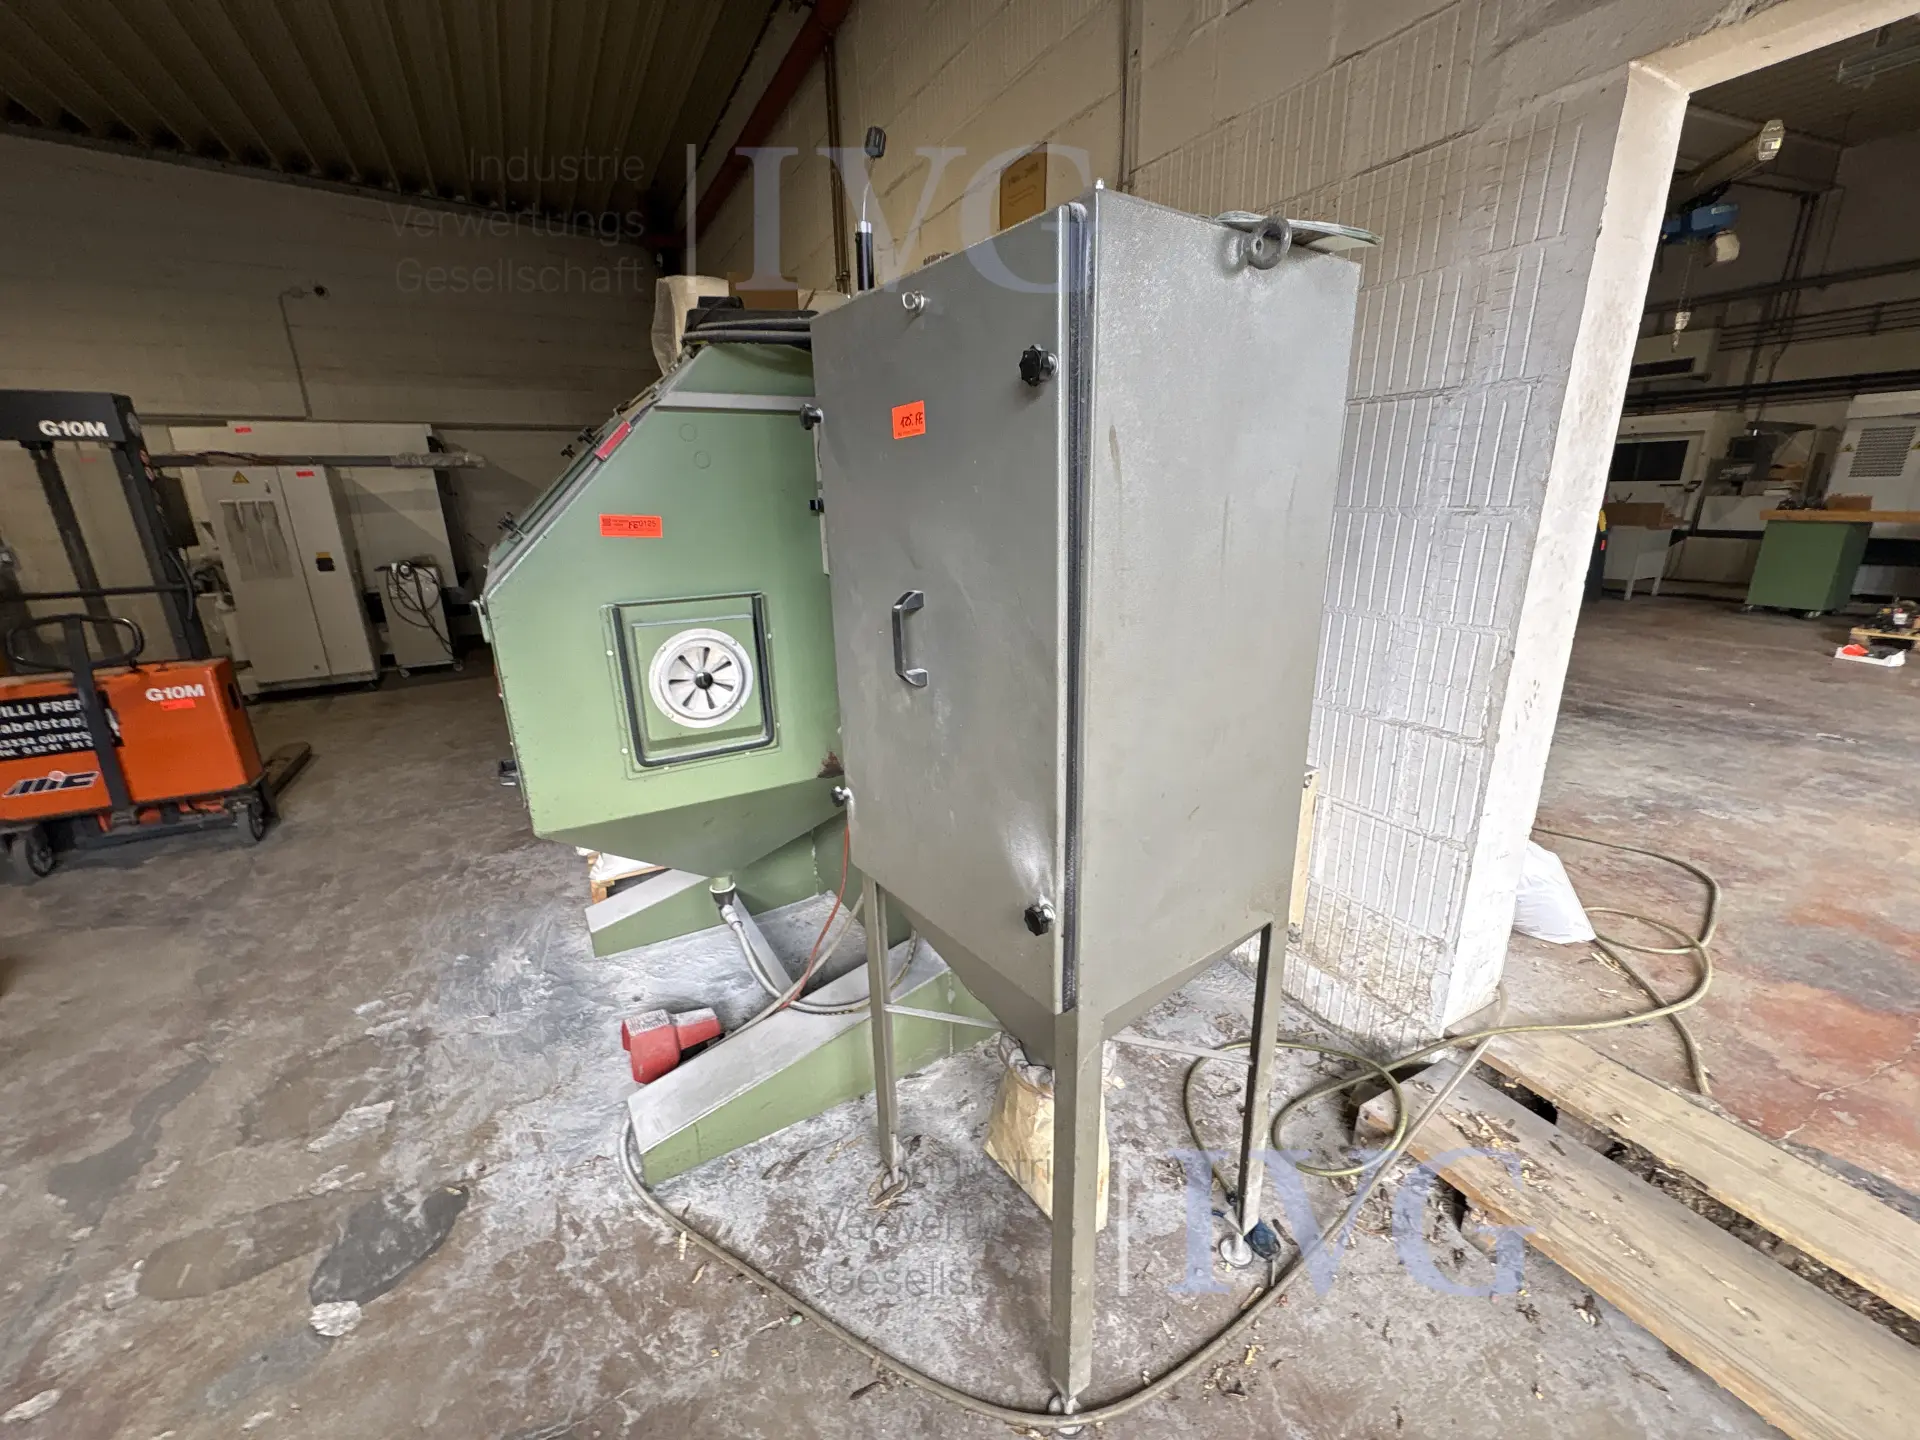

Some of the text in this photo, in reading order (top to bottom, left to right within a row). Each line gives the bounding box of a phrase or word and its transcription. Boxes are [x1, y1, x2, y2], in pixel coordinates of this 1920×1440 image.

[38, 420, 109, 437] G10M
[145, 684, 206, 702] G10M
[0, 704, 36, 717] ILLI
[0, 717, 82, 735] abelstap
